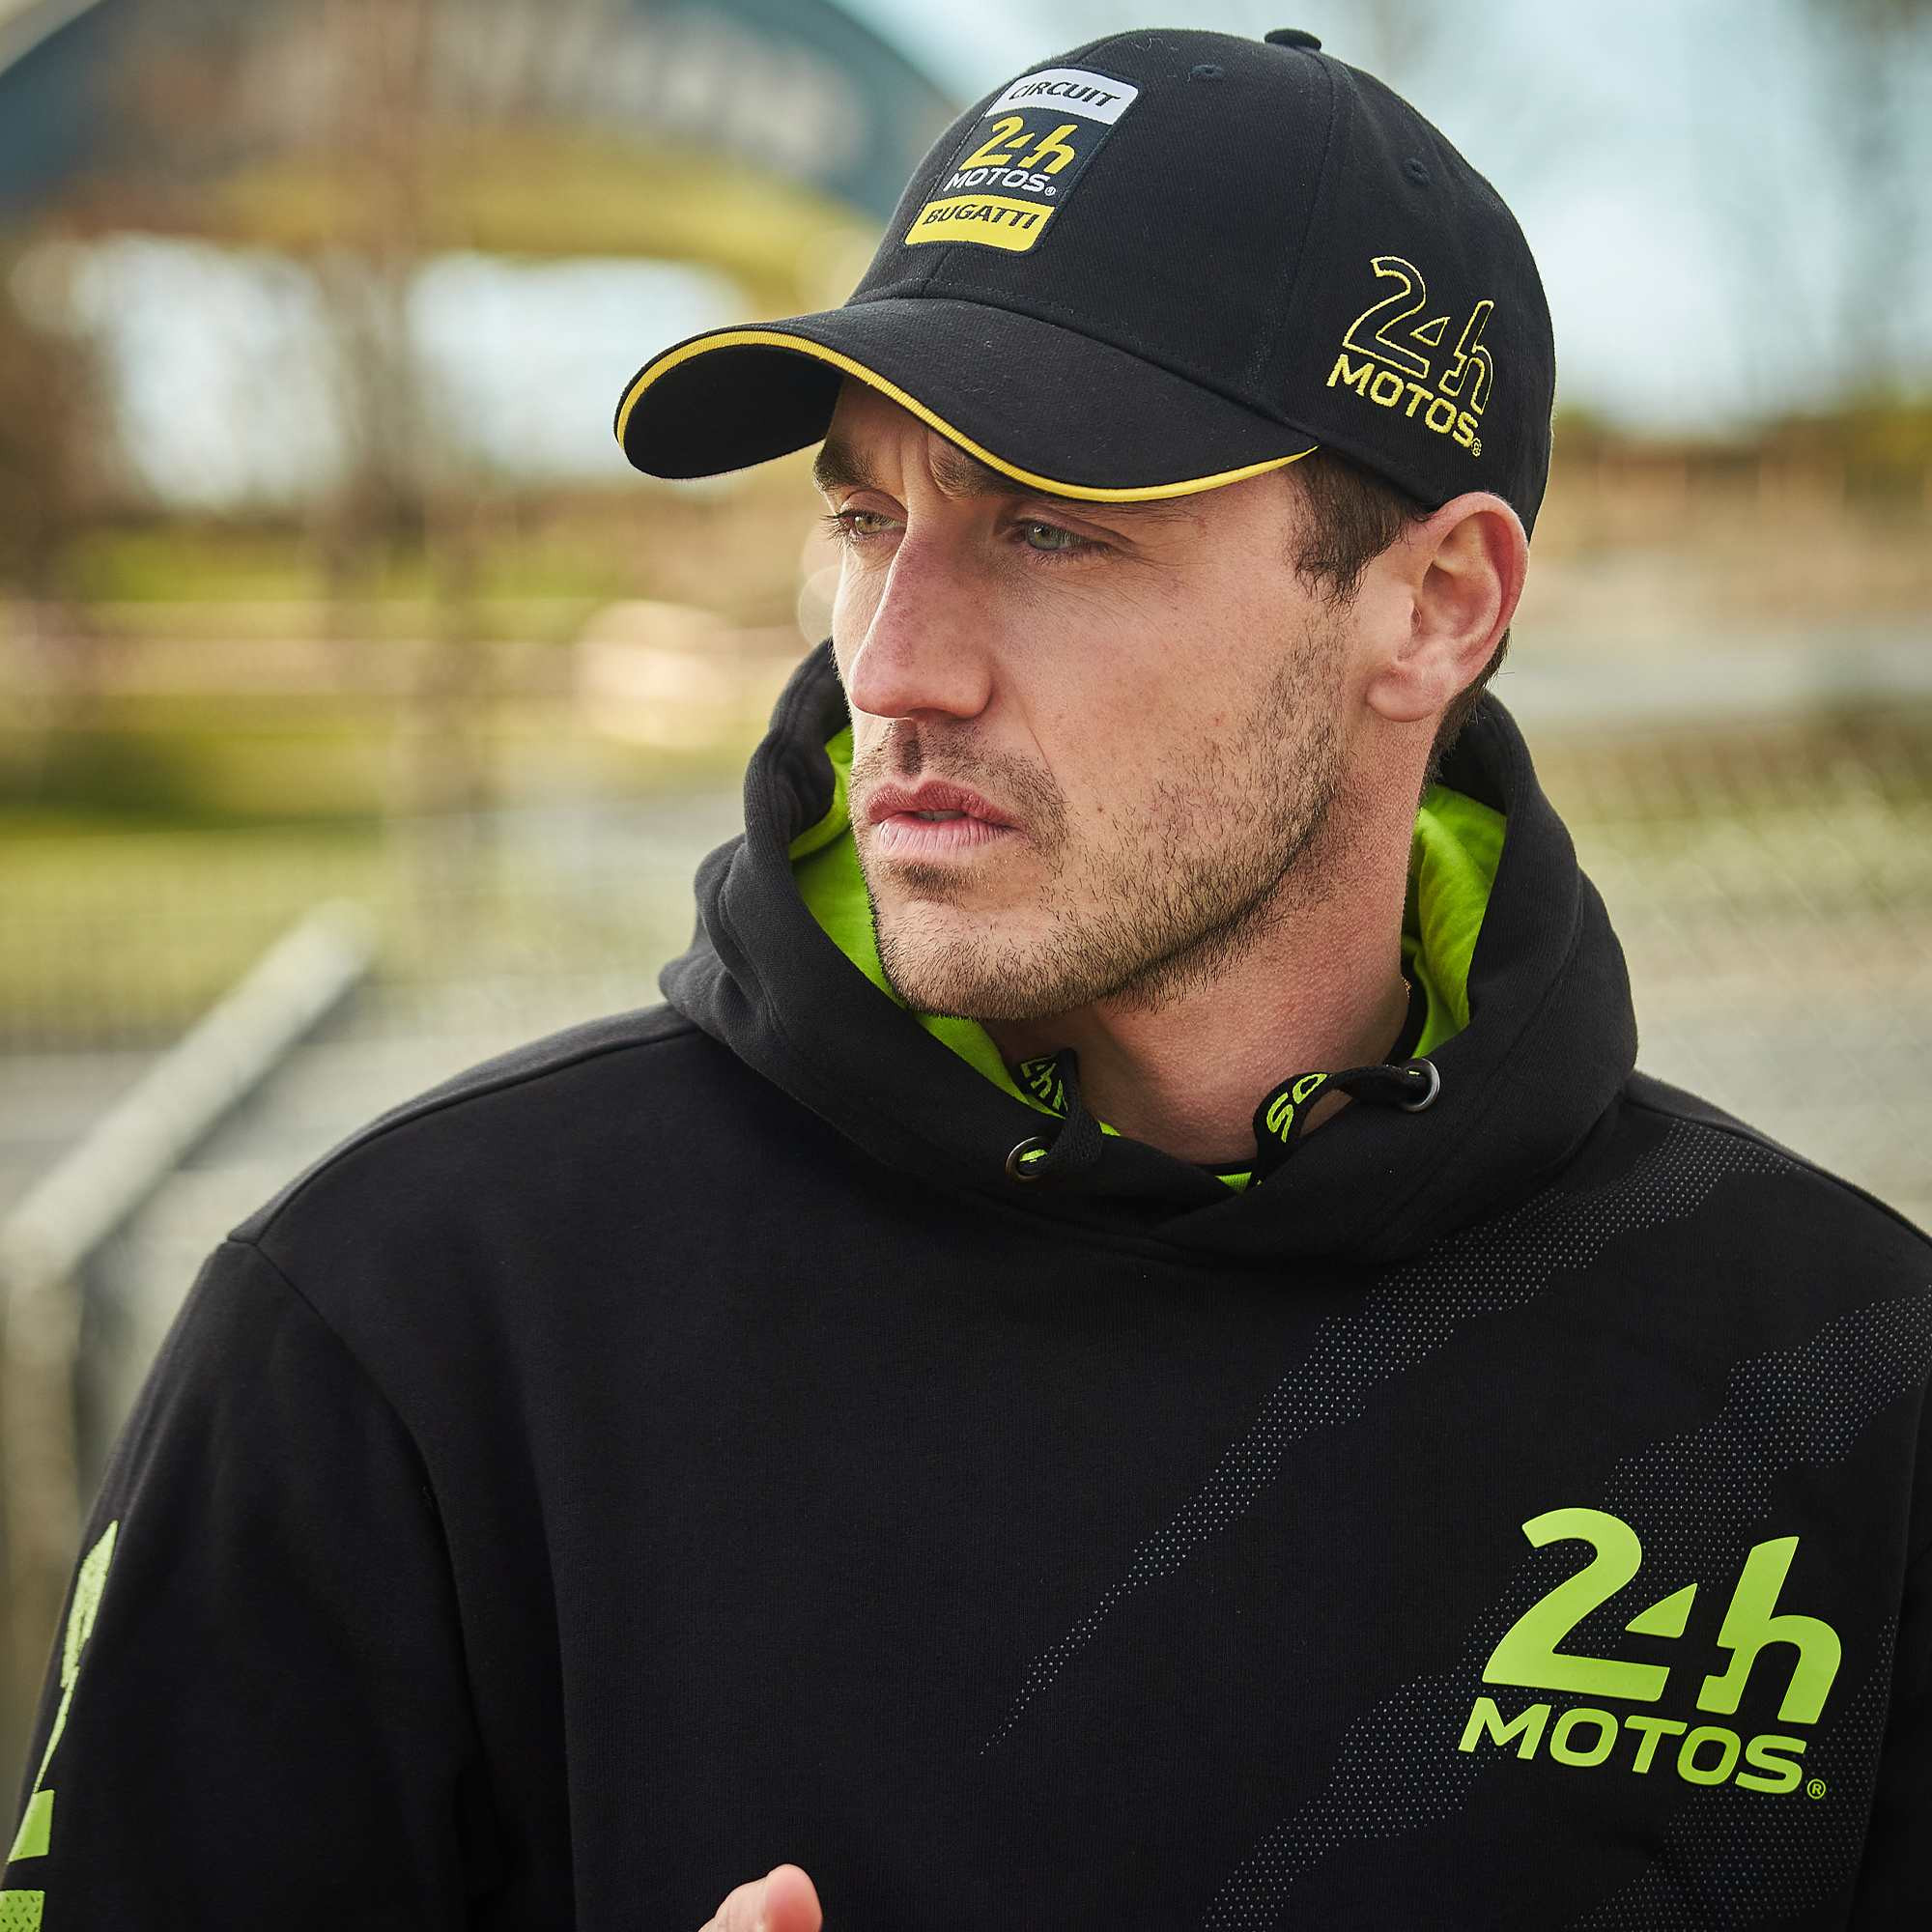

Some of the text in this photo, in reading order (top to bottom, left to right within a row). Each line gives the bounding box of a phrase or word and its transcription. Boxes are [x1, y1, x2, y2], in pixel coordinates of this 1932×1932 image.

[1009, 81, 1121, 107] CIRCUIT
[922, 204, 1040, 229] BUGATTI
[1482, 1507, 1841, 1724] 24h
